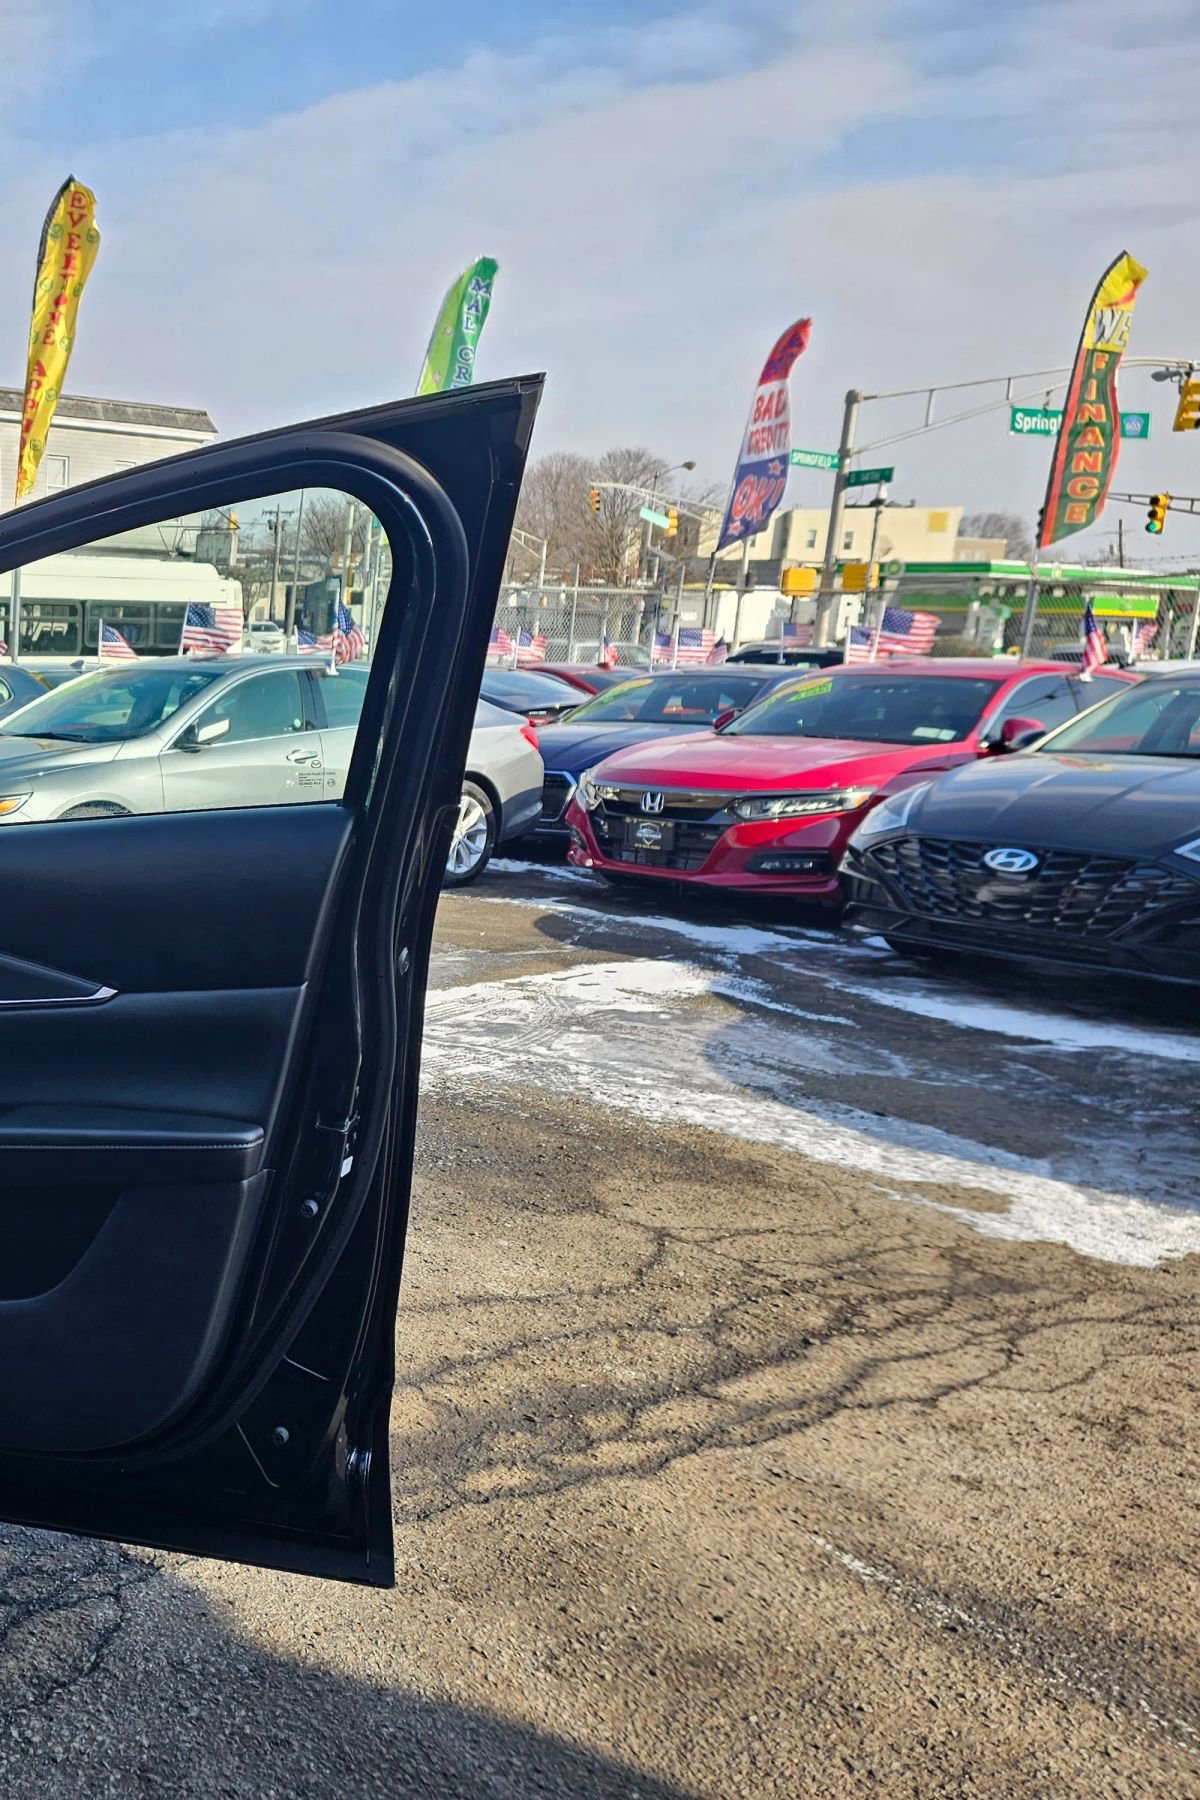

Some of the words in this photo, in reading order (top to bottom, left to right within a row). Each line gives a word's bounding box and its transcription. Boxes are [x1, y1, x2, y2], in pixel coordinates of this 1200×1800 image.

[464, 277, 492, 332] MAL
[1093, 308, 1134, 348] WE
[752, 387, 788, 425] BAD
[1063, 351, 1109, 525] FINANCE
[731, 473, 786, 523] OK!
